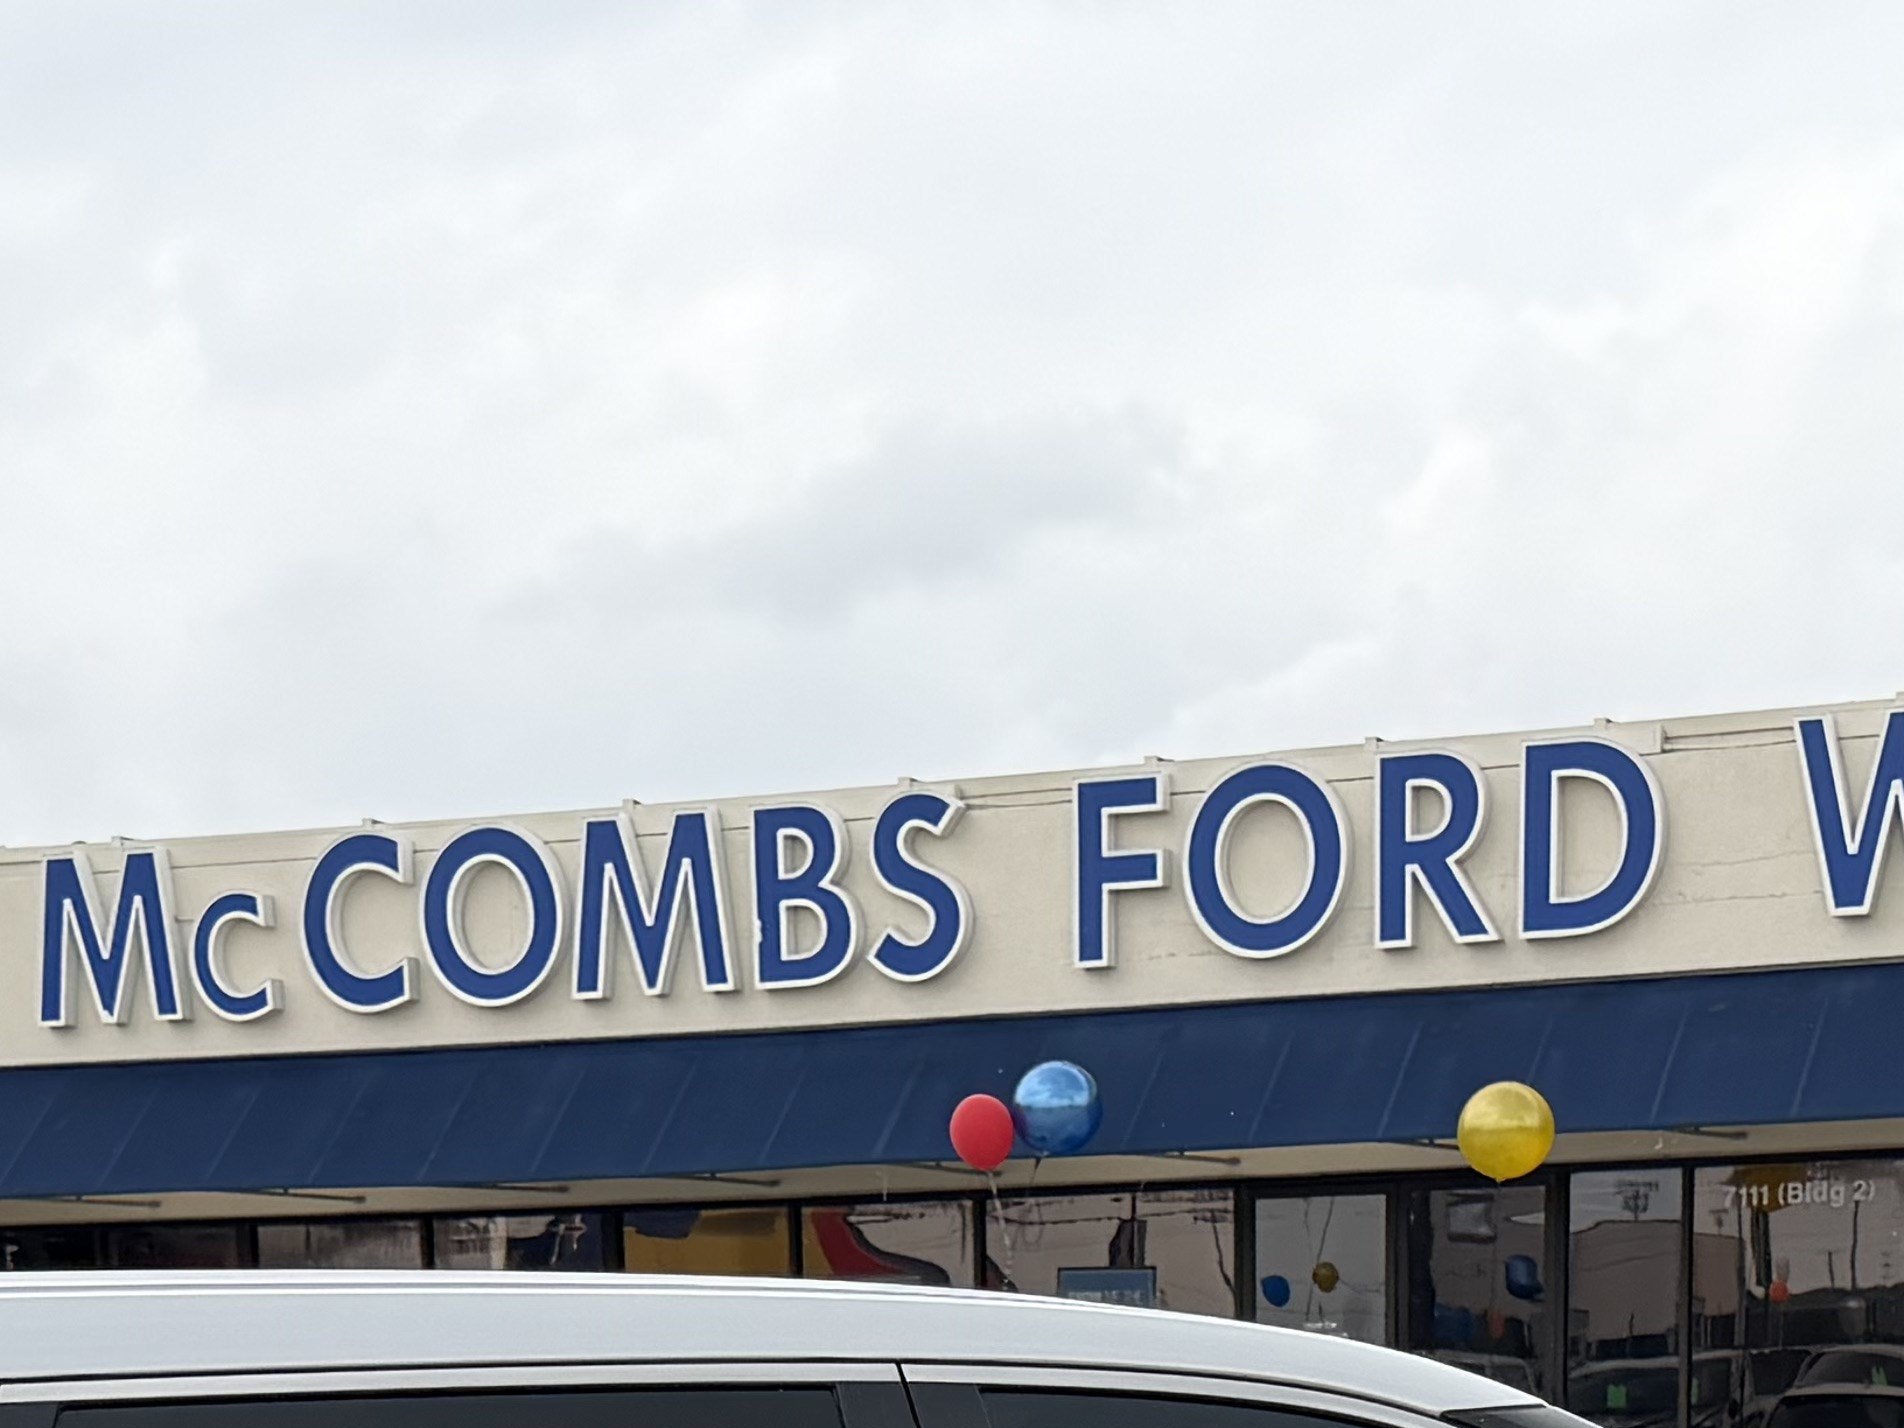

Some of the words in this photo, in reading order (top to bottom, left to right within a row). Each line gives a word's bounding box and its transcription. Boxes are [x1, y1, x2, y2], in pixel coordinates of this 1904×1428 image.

[38, 787, 973, 1025] McCOMBS
[1073, 735, 1669, 968] FORD
[1724, 1184, 1769, 1208] 7111
[1777, 1180, 1845, 1208] (Bldg
[1851, 1179, 1876, 1201] 2)
